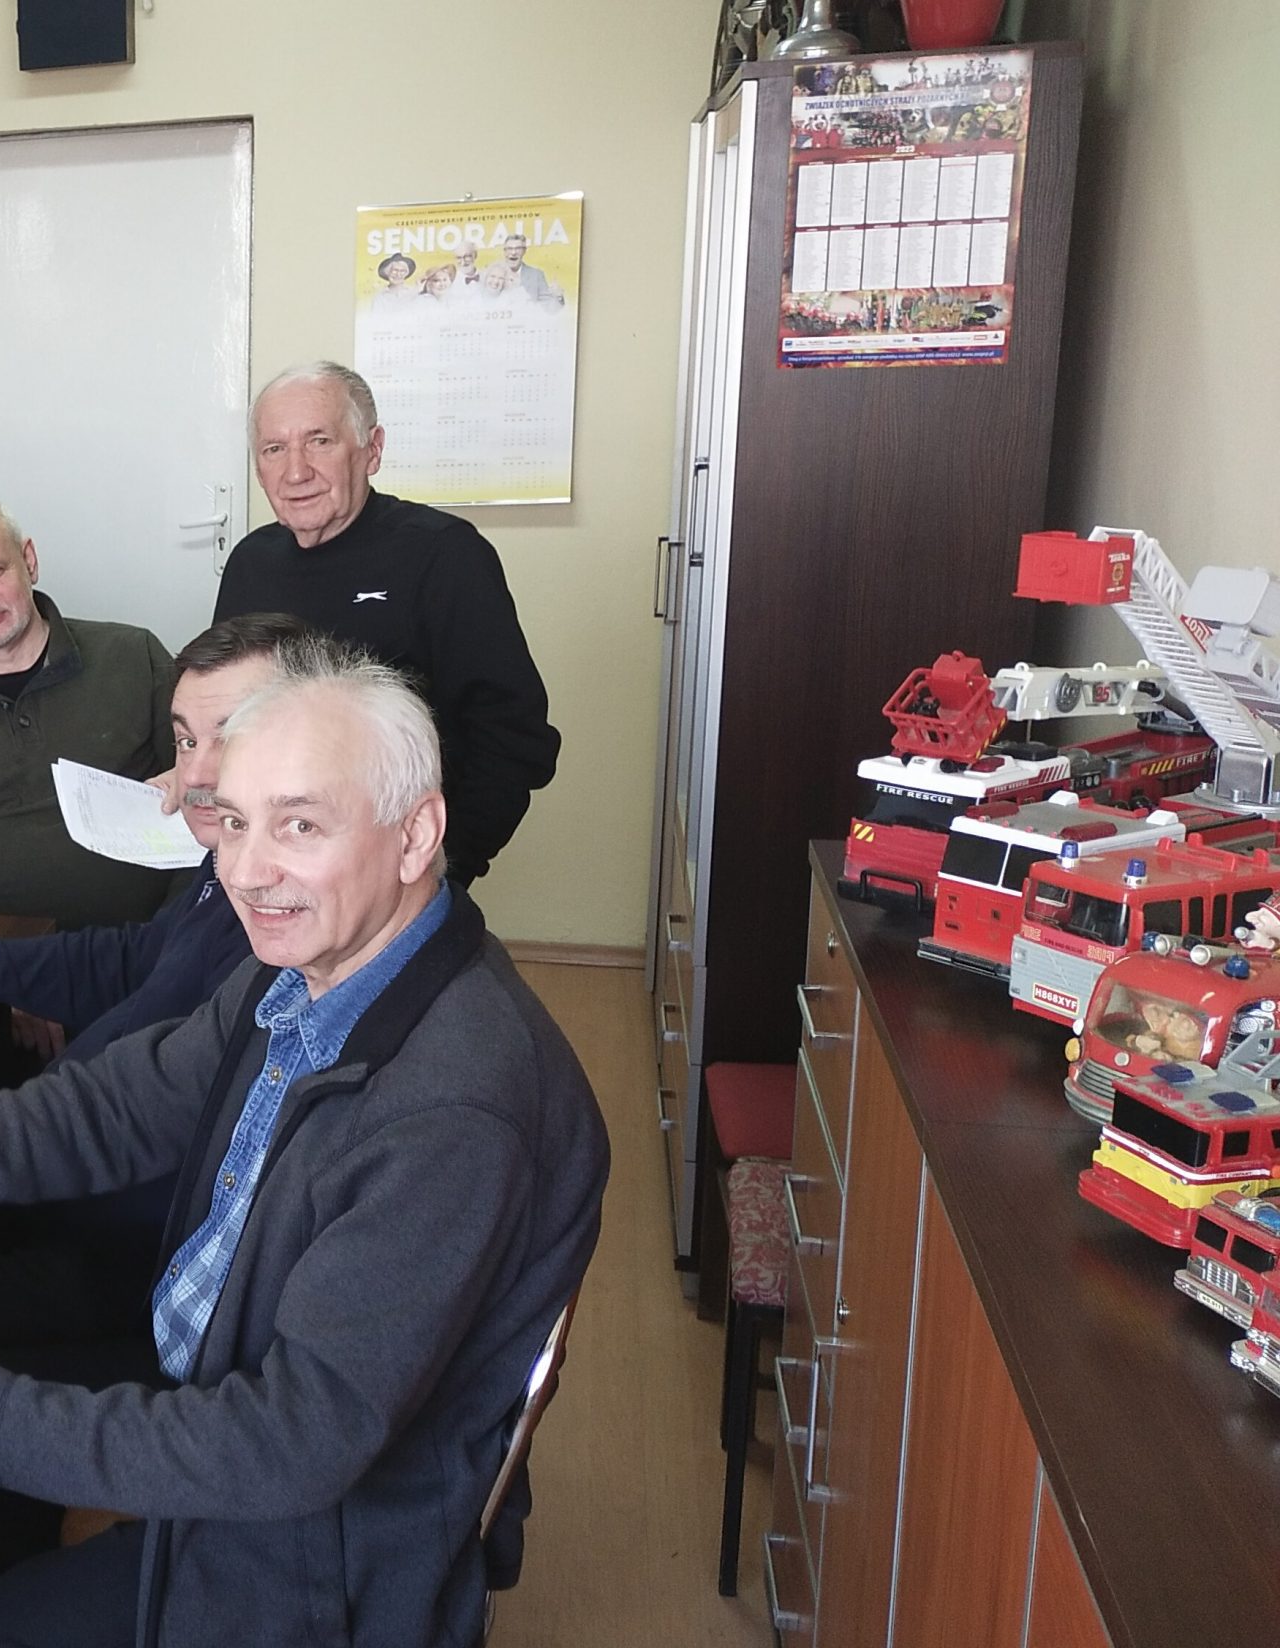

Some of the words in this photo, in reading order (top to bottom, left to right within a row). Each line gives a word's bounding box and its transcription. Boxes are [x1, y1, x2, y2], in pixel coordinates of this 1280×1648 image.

[366, 218, 570, 256] SENIORALIA
[1176, 755, 1199, 767] FIRE
[876, 783, 903, 796] FIRE
[907, 790, 954, 805] RESCUE
[1035, 987, 1077, 1010] H868XYF
